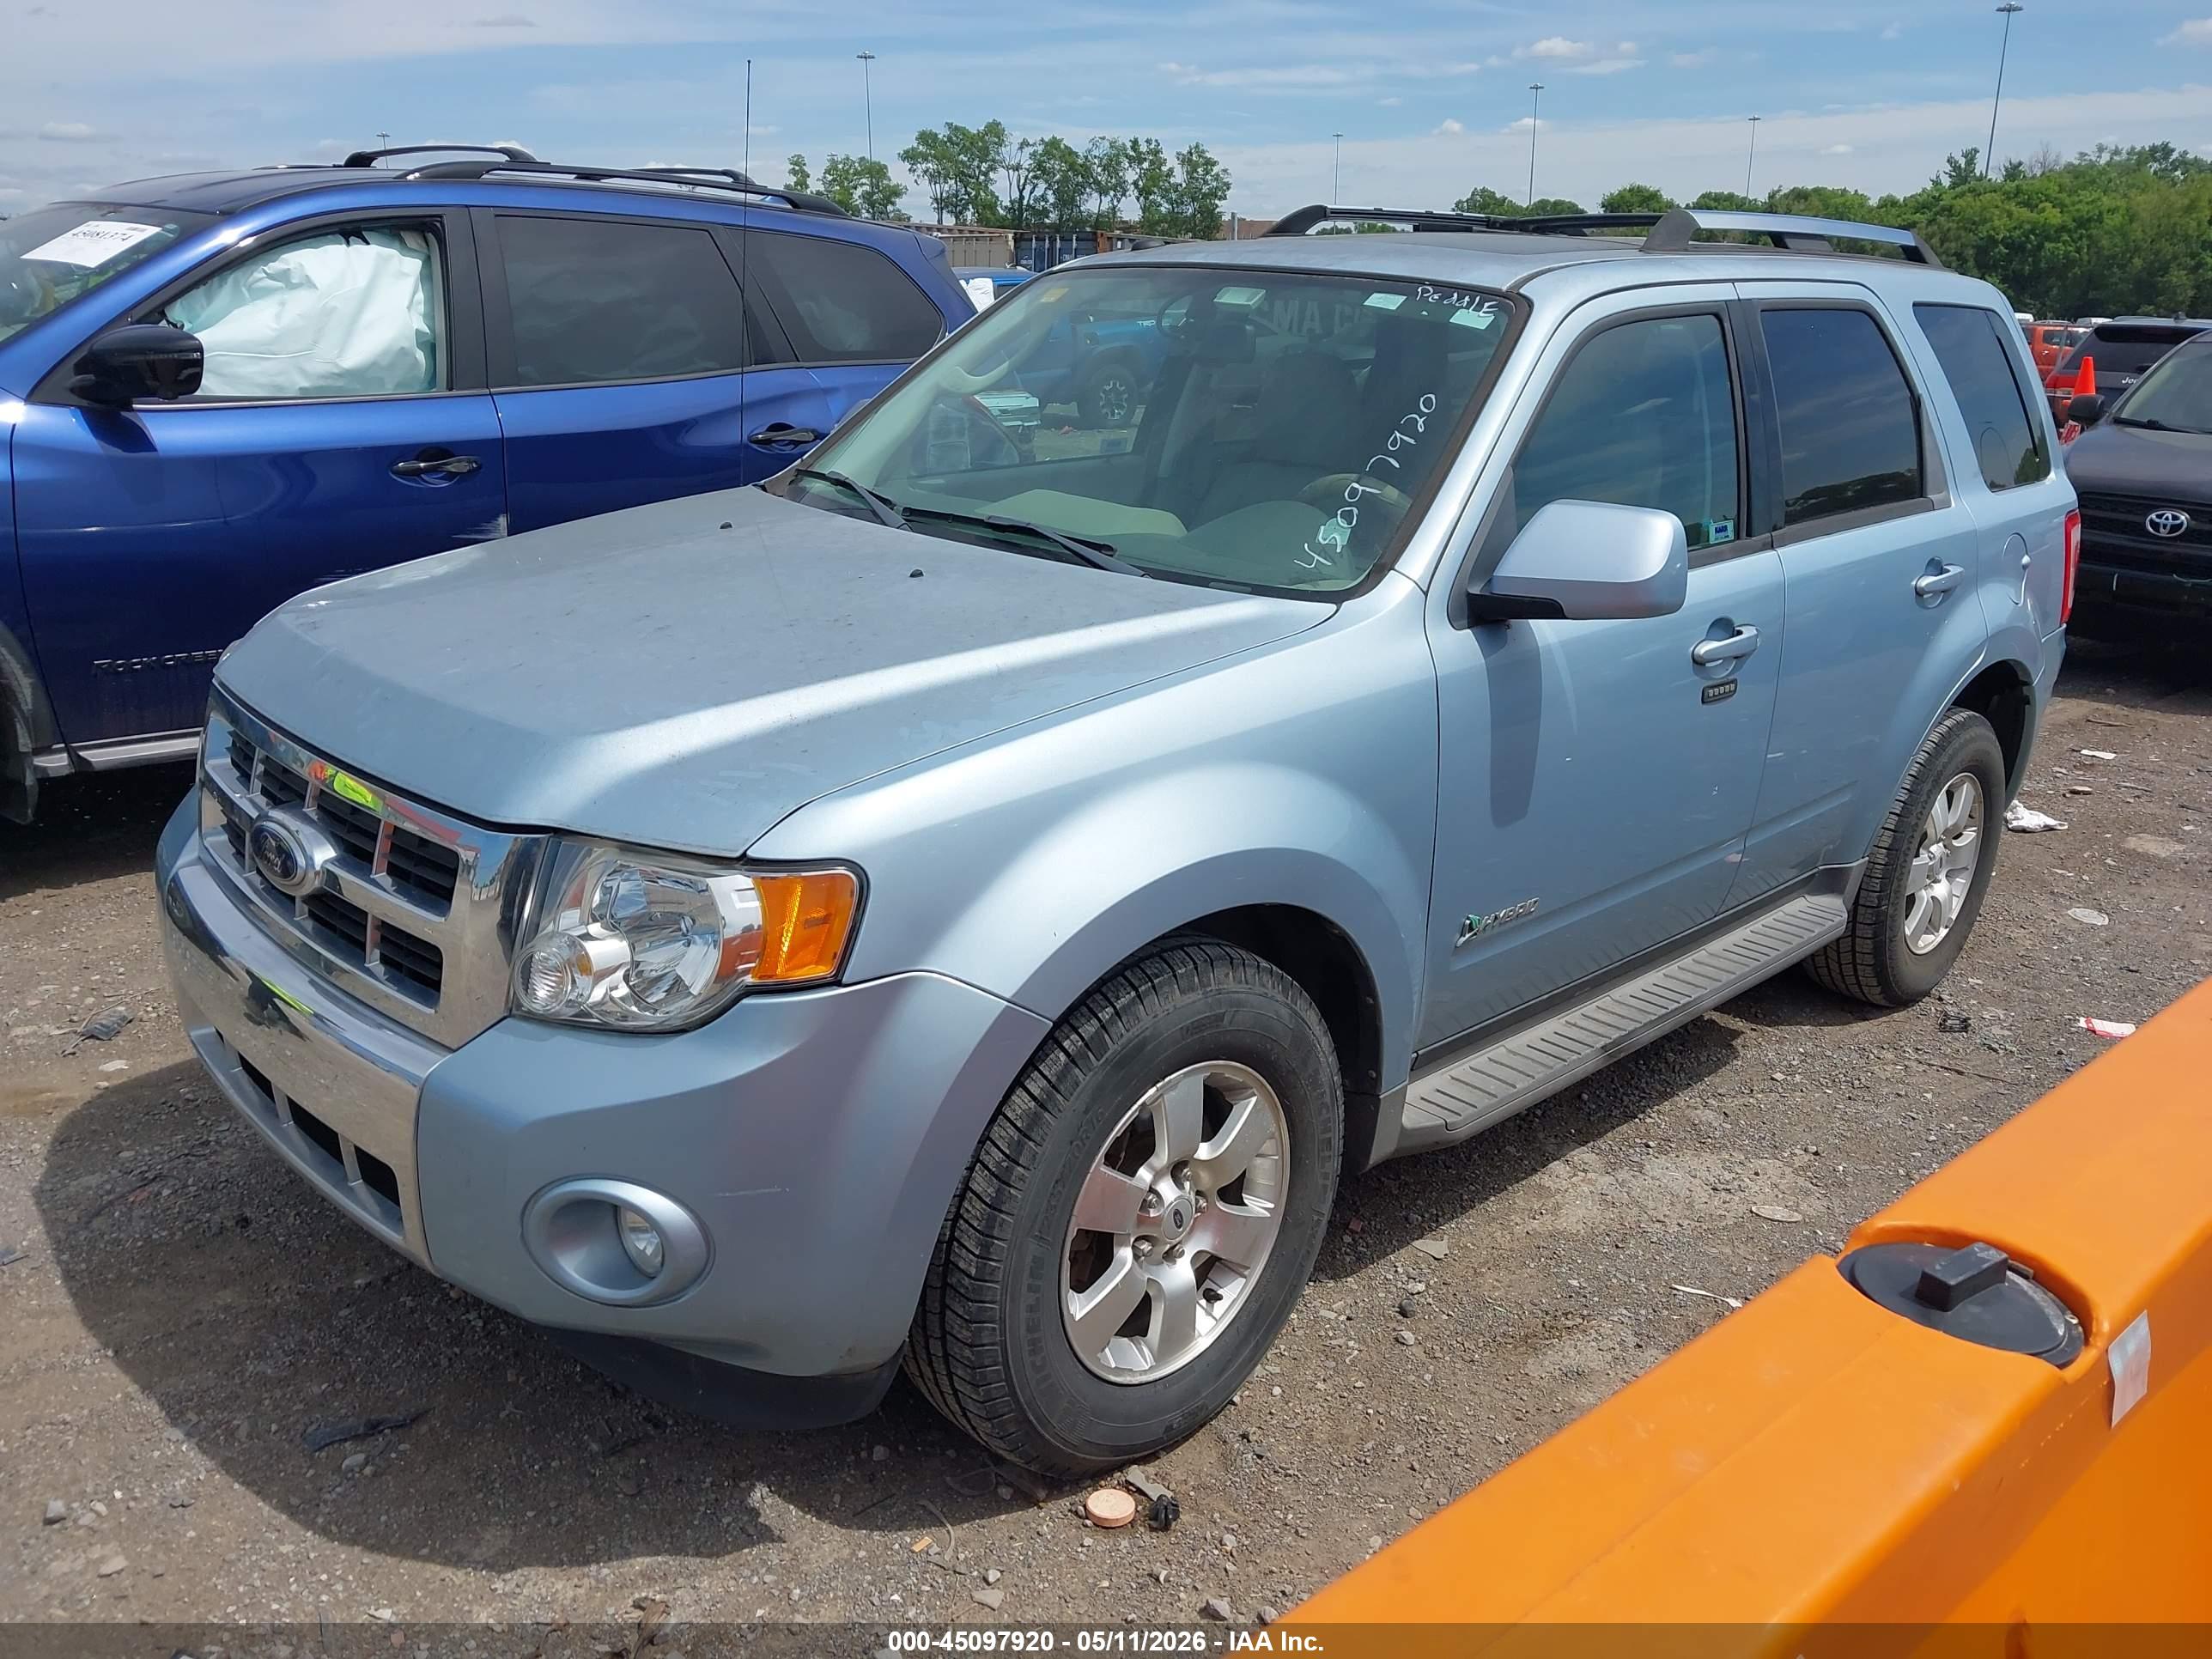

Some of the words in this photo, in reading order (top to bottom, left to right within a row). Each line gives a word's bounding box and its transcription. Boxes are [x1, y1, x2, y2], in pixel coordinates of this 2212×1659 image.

[2121, 376, 2139, 385] Je
[1293, 392, 1437, 569] 45097920
[92, 657, 157, 676] ROCK
[161, 649, 223, 668] CREE
